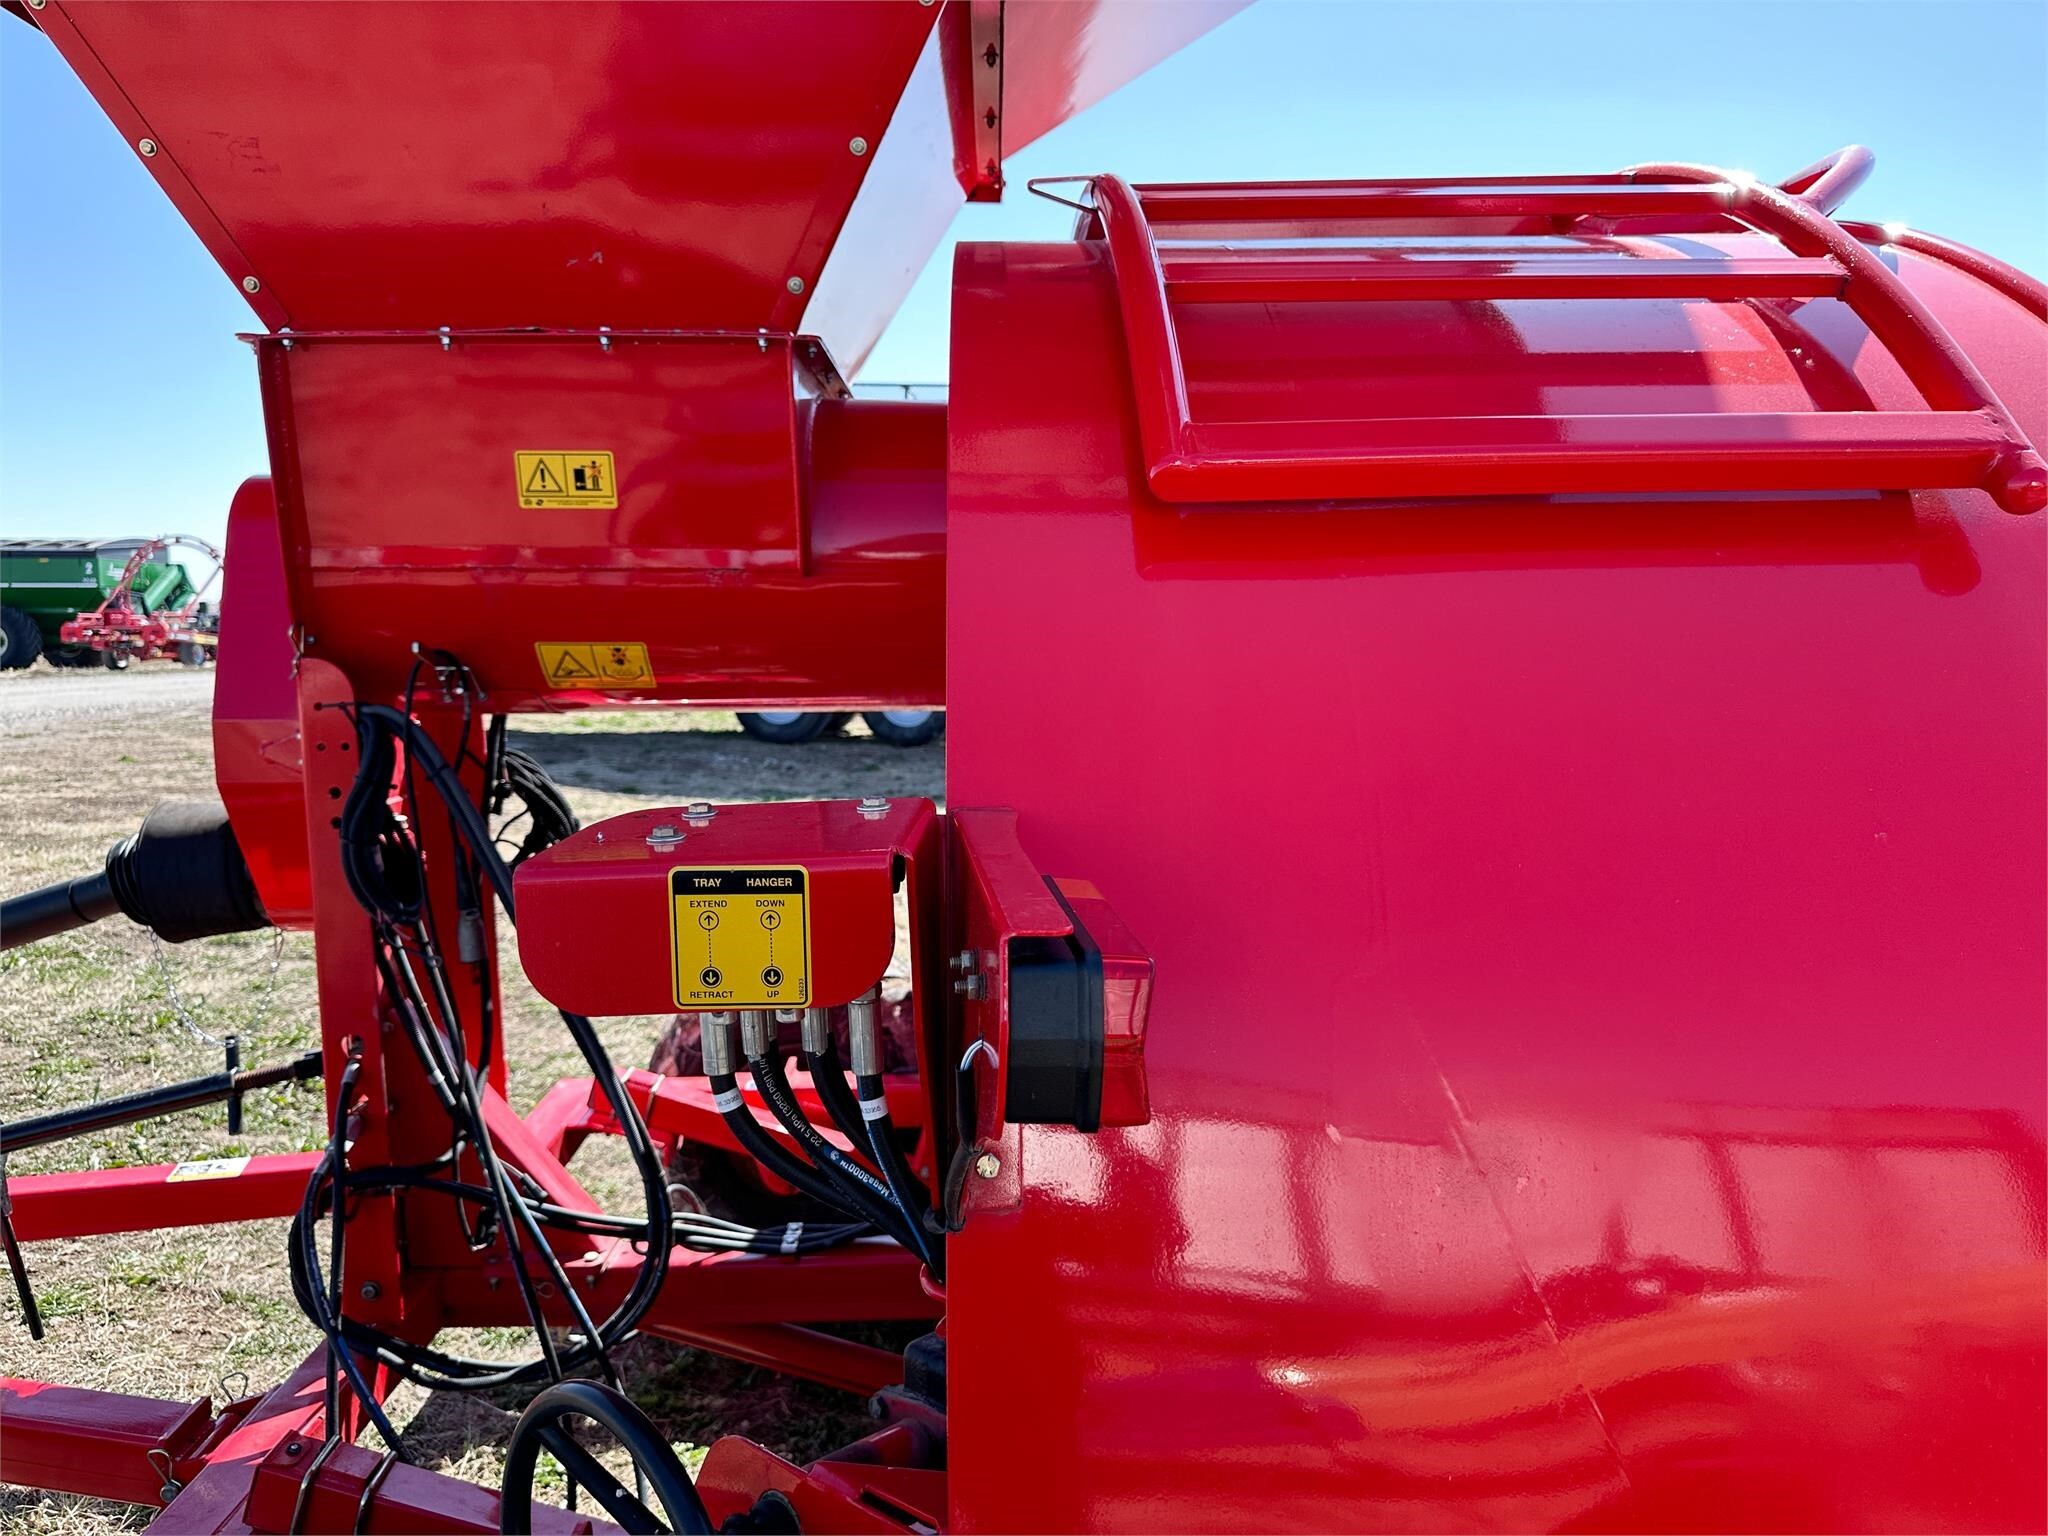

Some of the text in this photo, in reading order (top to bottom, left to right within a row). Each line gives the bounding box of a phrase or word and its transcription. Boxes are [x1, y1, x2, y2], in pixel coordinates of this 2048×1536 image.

[693, 877, 793, 888] TRAY HANGER
[689, 899, 728, 908] EXTEND
[755, 899, 785, 908] DOWN
[689, 990, 734, 999] RETRACT
[766, 990, 780, 999] UP
[791, 1113, 807, 1132] MPa
